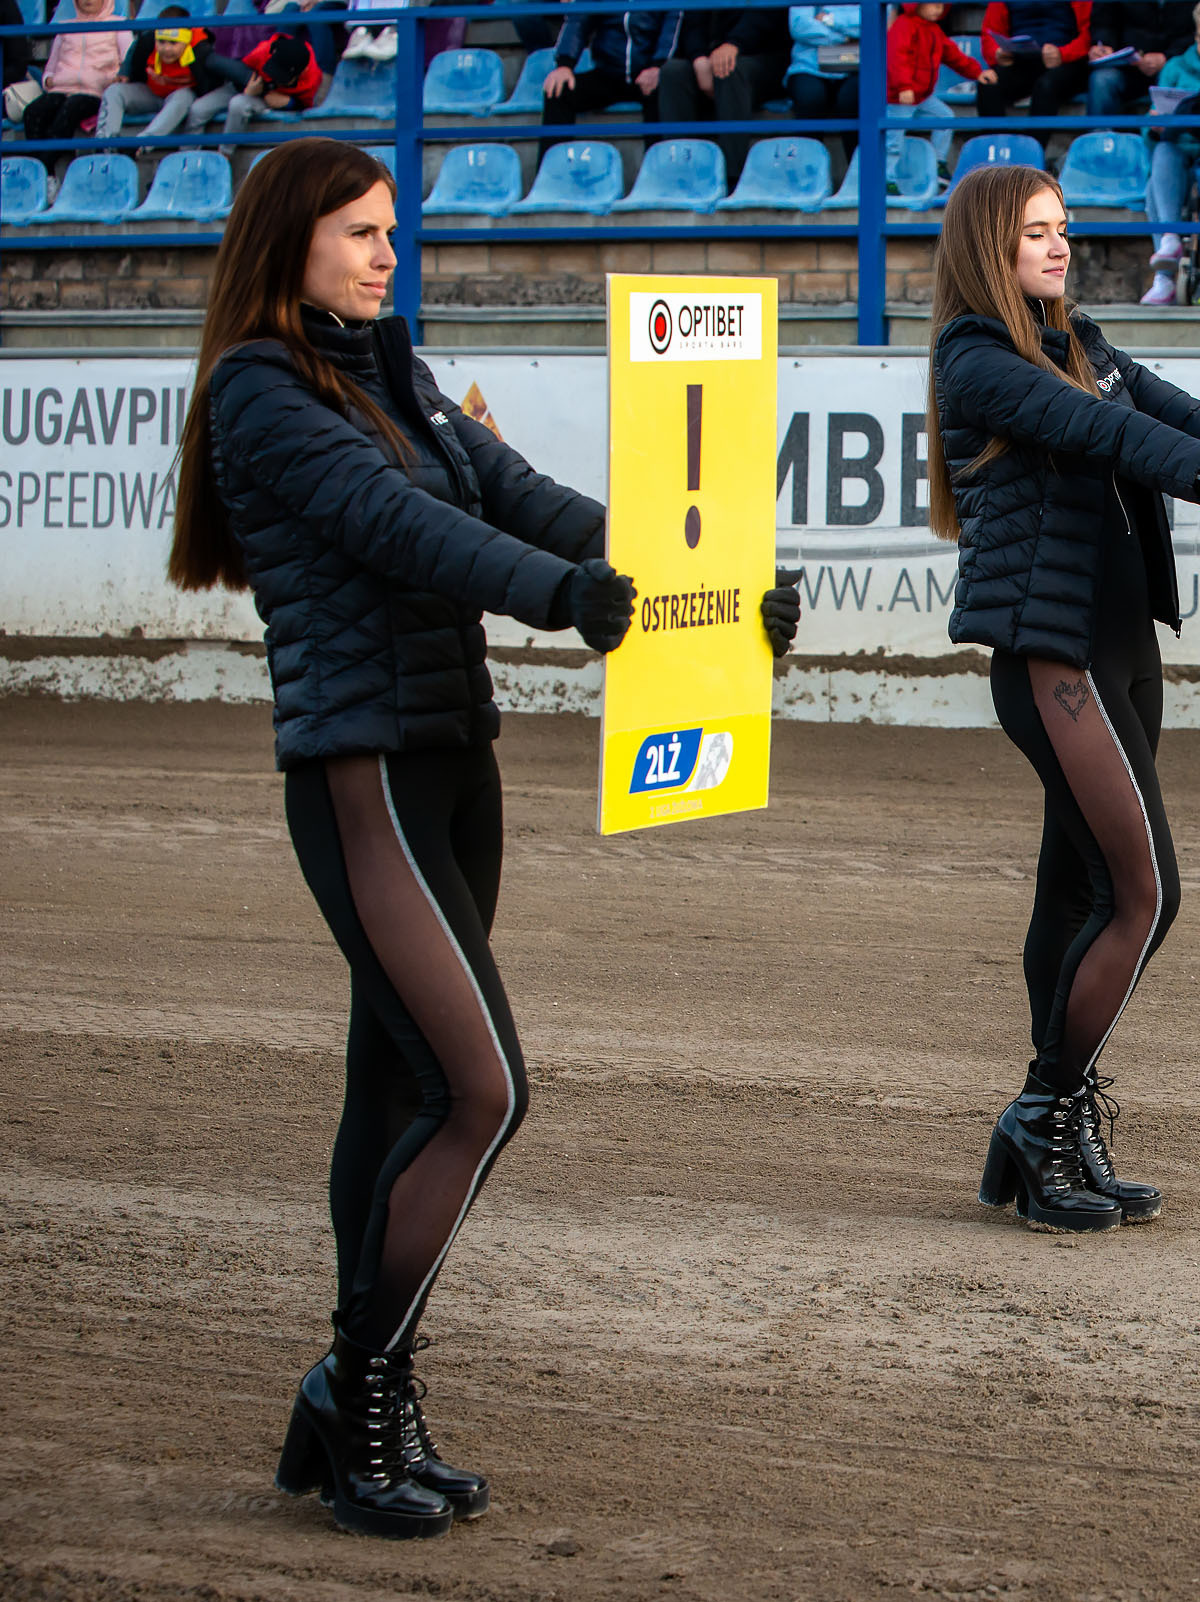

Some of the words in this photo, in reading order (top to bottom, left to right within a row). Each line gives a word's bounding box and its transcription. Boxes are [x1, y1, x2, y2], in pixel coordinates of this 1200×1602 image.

[679, 305, 744, 337] OPTIBET
[641, 582, 740, 633] OSTRZEŻENIE
[645, 733, 682, 784] 2LŻ
